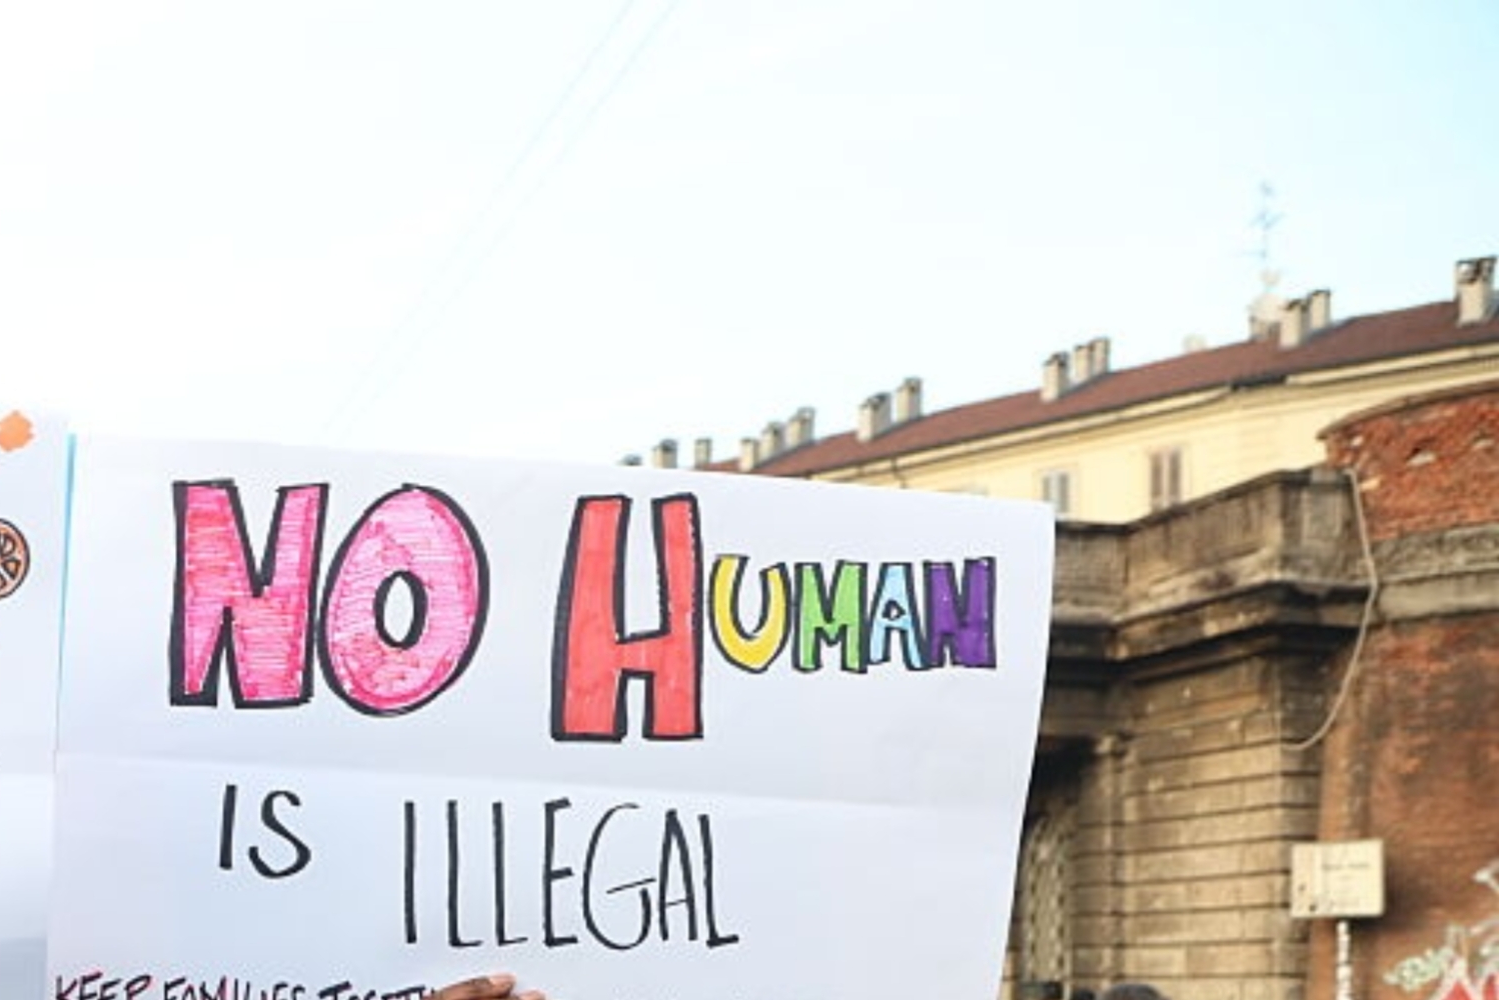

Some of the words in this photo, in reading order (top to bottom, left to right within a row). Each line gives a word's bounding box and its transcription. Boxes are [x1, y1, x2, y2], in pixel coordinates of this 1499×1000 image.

[168, 478, 491, 717] NO
[550, 492, 997, 743] HUMAN
[219, 784, 312, 880] IS
[403, 797, 740, 951] ILLEGAL
